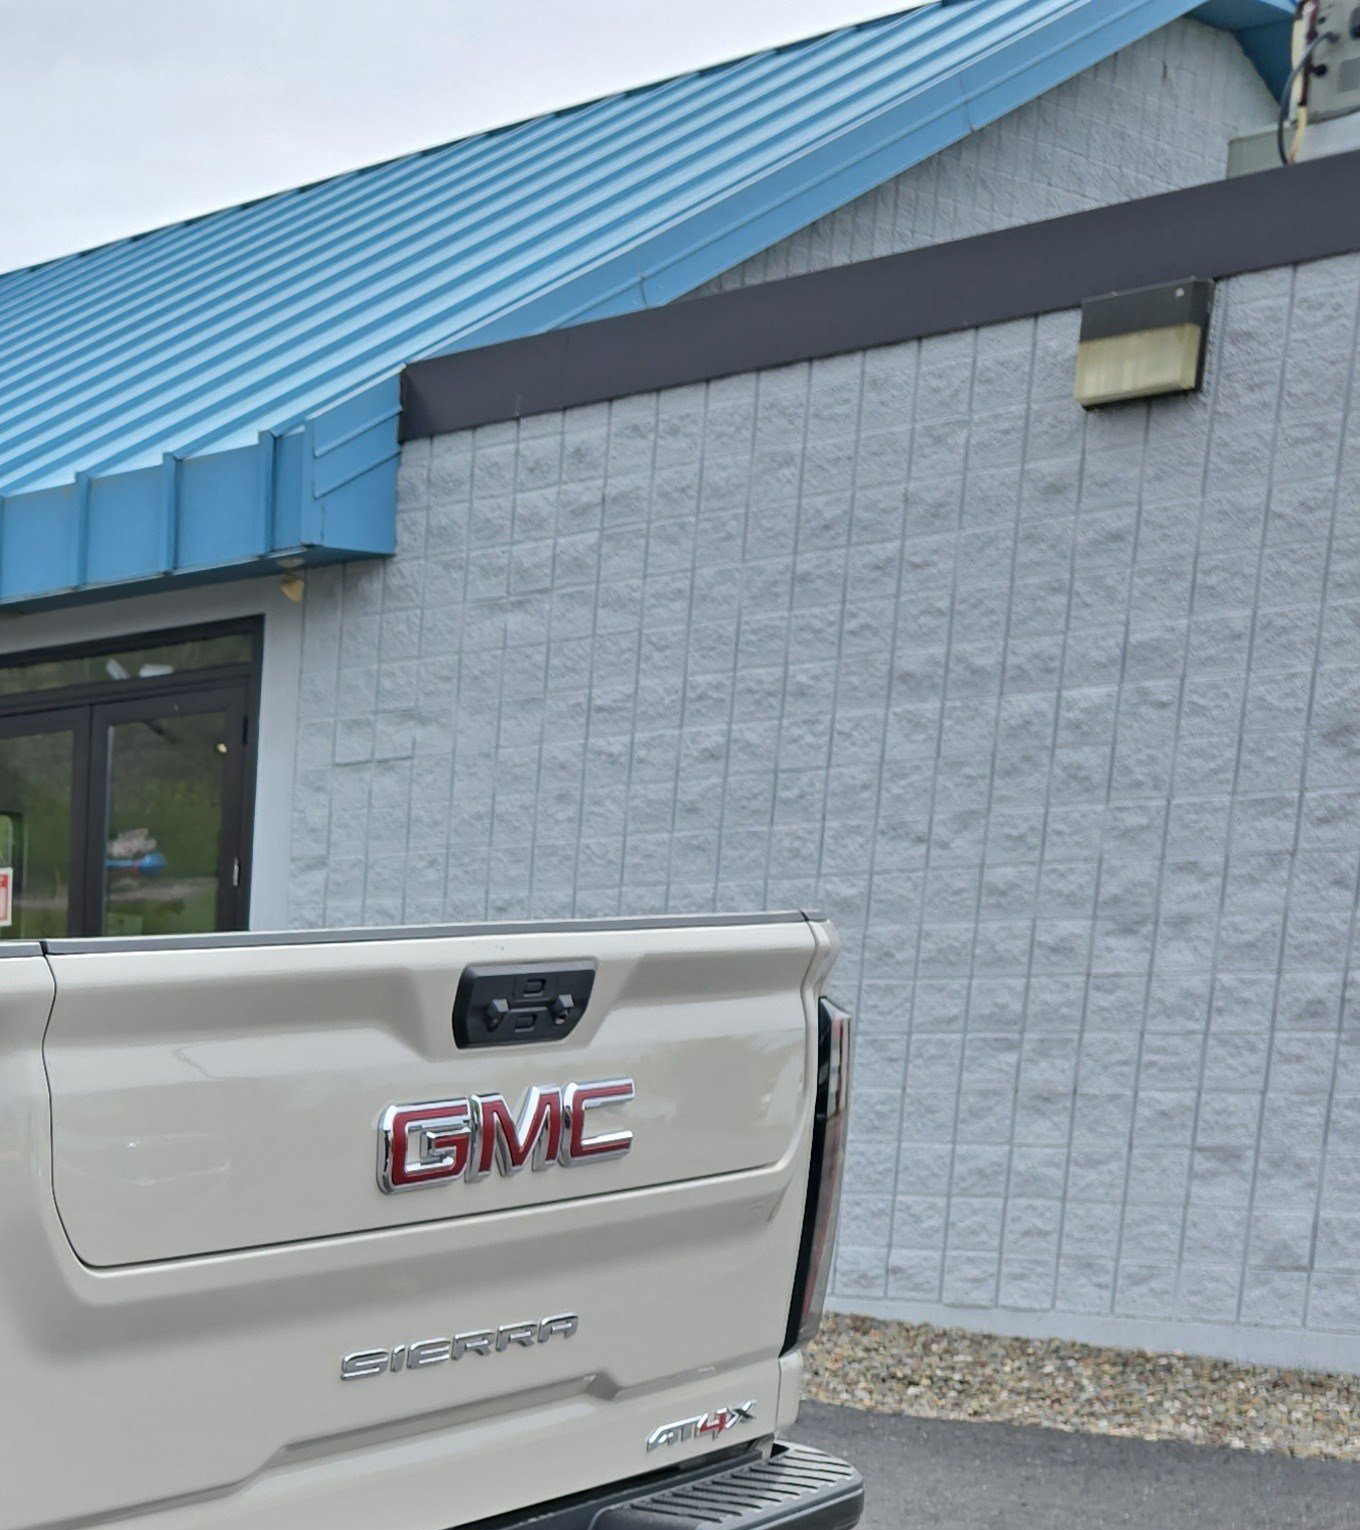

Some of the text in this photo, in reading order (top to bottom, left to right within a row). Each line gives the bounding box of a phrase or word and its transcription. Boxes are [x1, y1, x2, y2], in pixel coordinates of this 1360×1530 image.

[376, 1077, 635, 1194] GMC
[340, 1312, 579, 1381] SIERRA
[645, 1399, 758, 1453] AT4X
